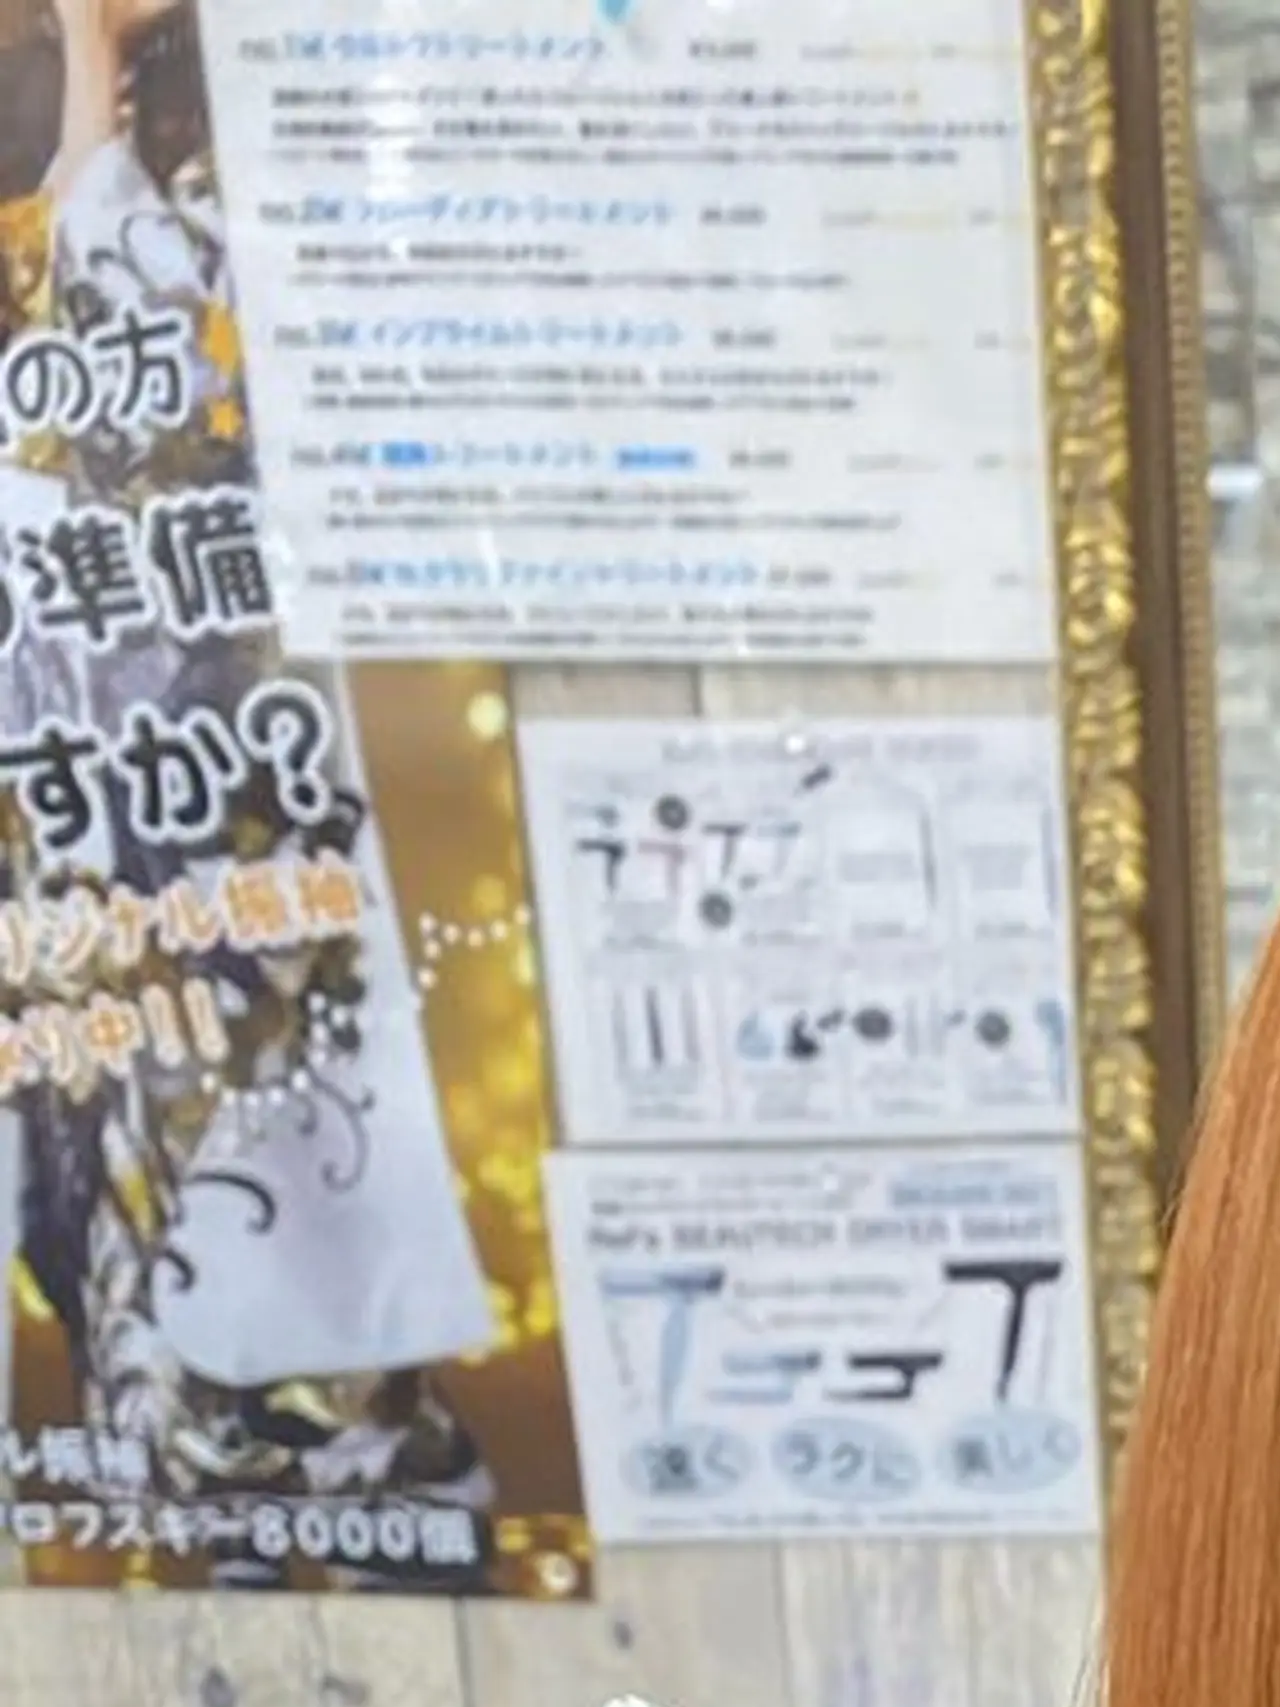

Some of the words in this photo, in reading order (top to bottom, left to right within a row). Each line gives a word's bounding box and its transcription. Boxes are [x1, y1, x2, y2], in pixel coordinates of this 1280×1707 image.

[0, 310, 183, 428] の方
[0, 498, 273, 641] 準備
[0, 1500, 478, 1566] ロフスキー8000個
